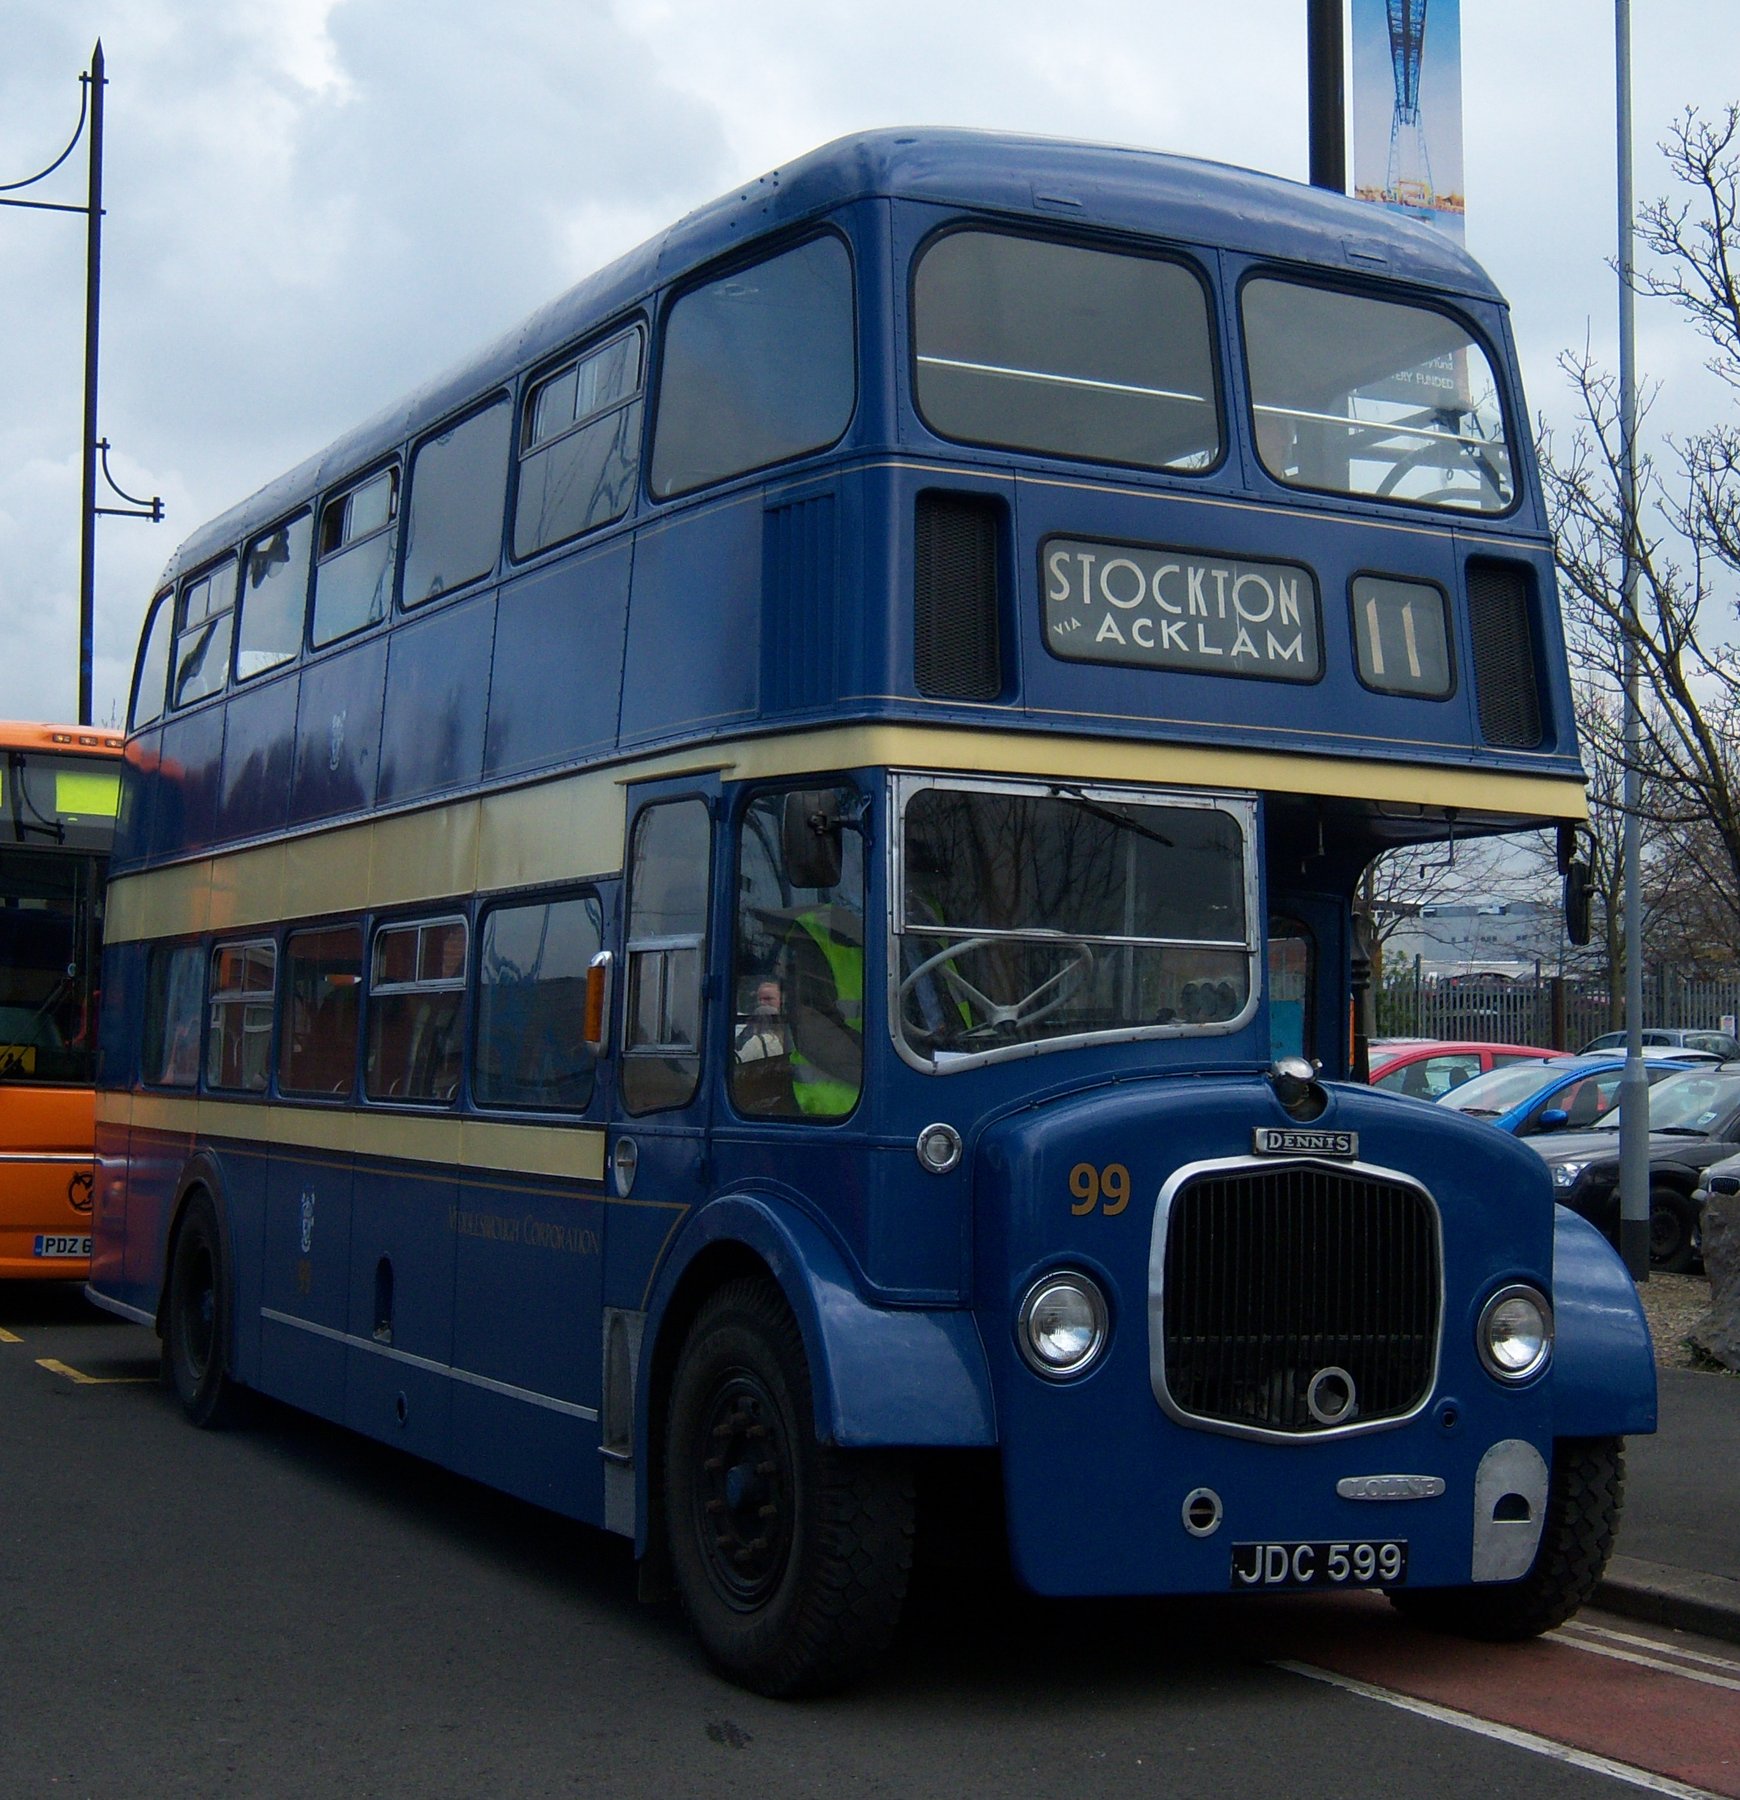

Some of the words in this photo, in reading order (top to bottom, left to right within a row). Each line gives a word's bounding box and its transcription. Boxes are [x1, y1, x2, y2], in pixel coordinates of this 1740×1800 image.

[1416, 372, 1454, 390] FUNDED
[1050, 551, 1300, 625] STOCKTON
[1053, 616, 1082, 635] VIA
[1095, 612, 1304, 663] ACKLAM
[1366, 597, 1421, 677] 11
[1268, 1131, 1350, 1151] DENNIS
[1069, 1162, 1131, 1216] 99
[45, 1238, 78, 1254] PDZ
[1349, 1479, 1436, 1497] LOLINE
[1238, 1545, 1315, 1584] JDC
[1327, 1543, 1401, 1582] 599
